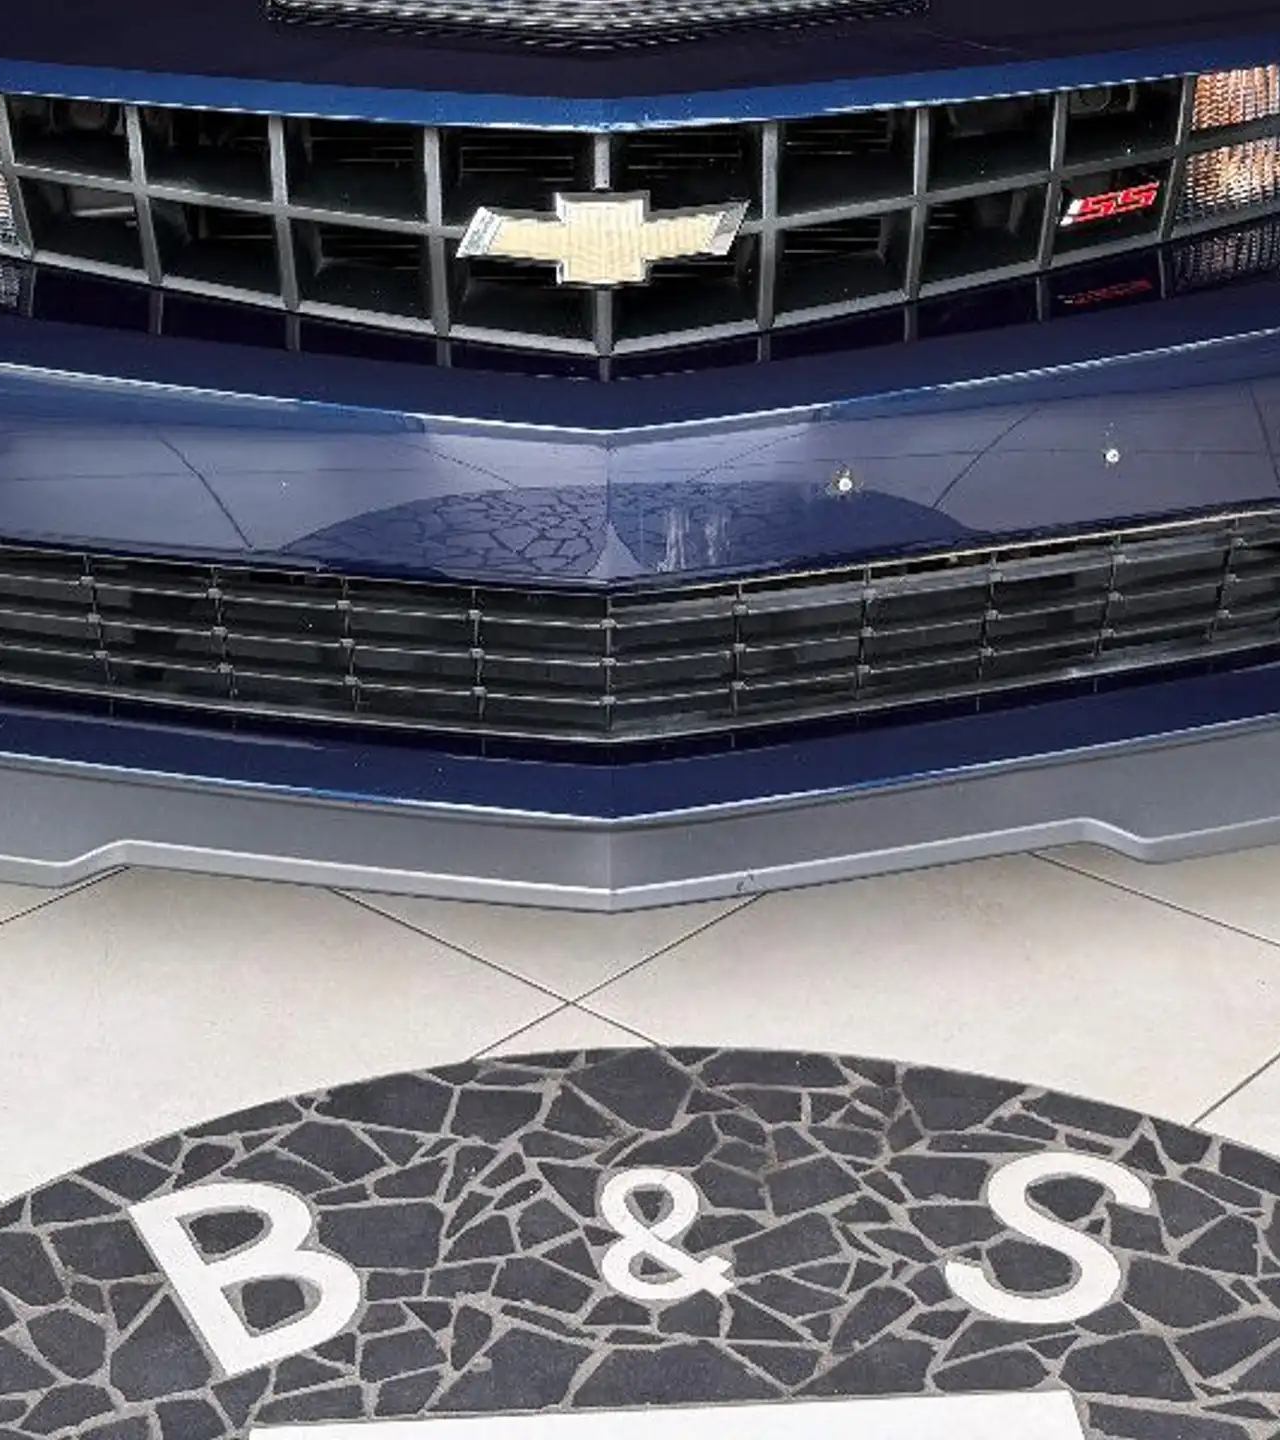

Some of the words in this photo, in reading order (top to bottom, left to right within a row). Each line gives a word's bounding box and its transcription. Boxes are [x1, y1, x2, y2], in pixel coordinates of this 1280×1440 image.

[127, 1180, 360, 1380] B
[599, 1167, 737, 1300] &
[943, 1155, 1153, 1325] S
